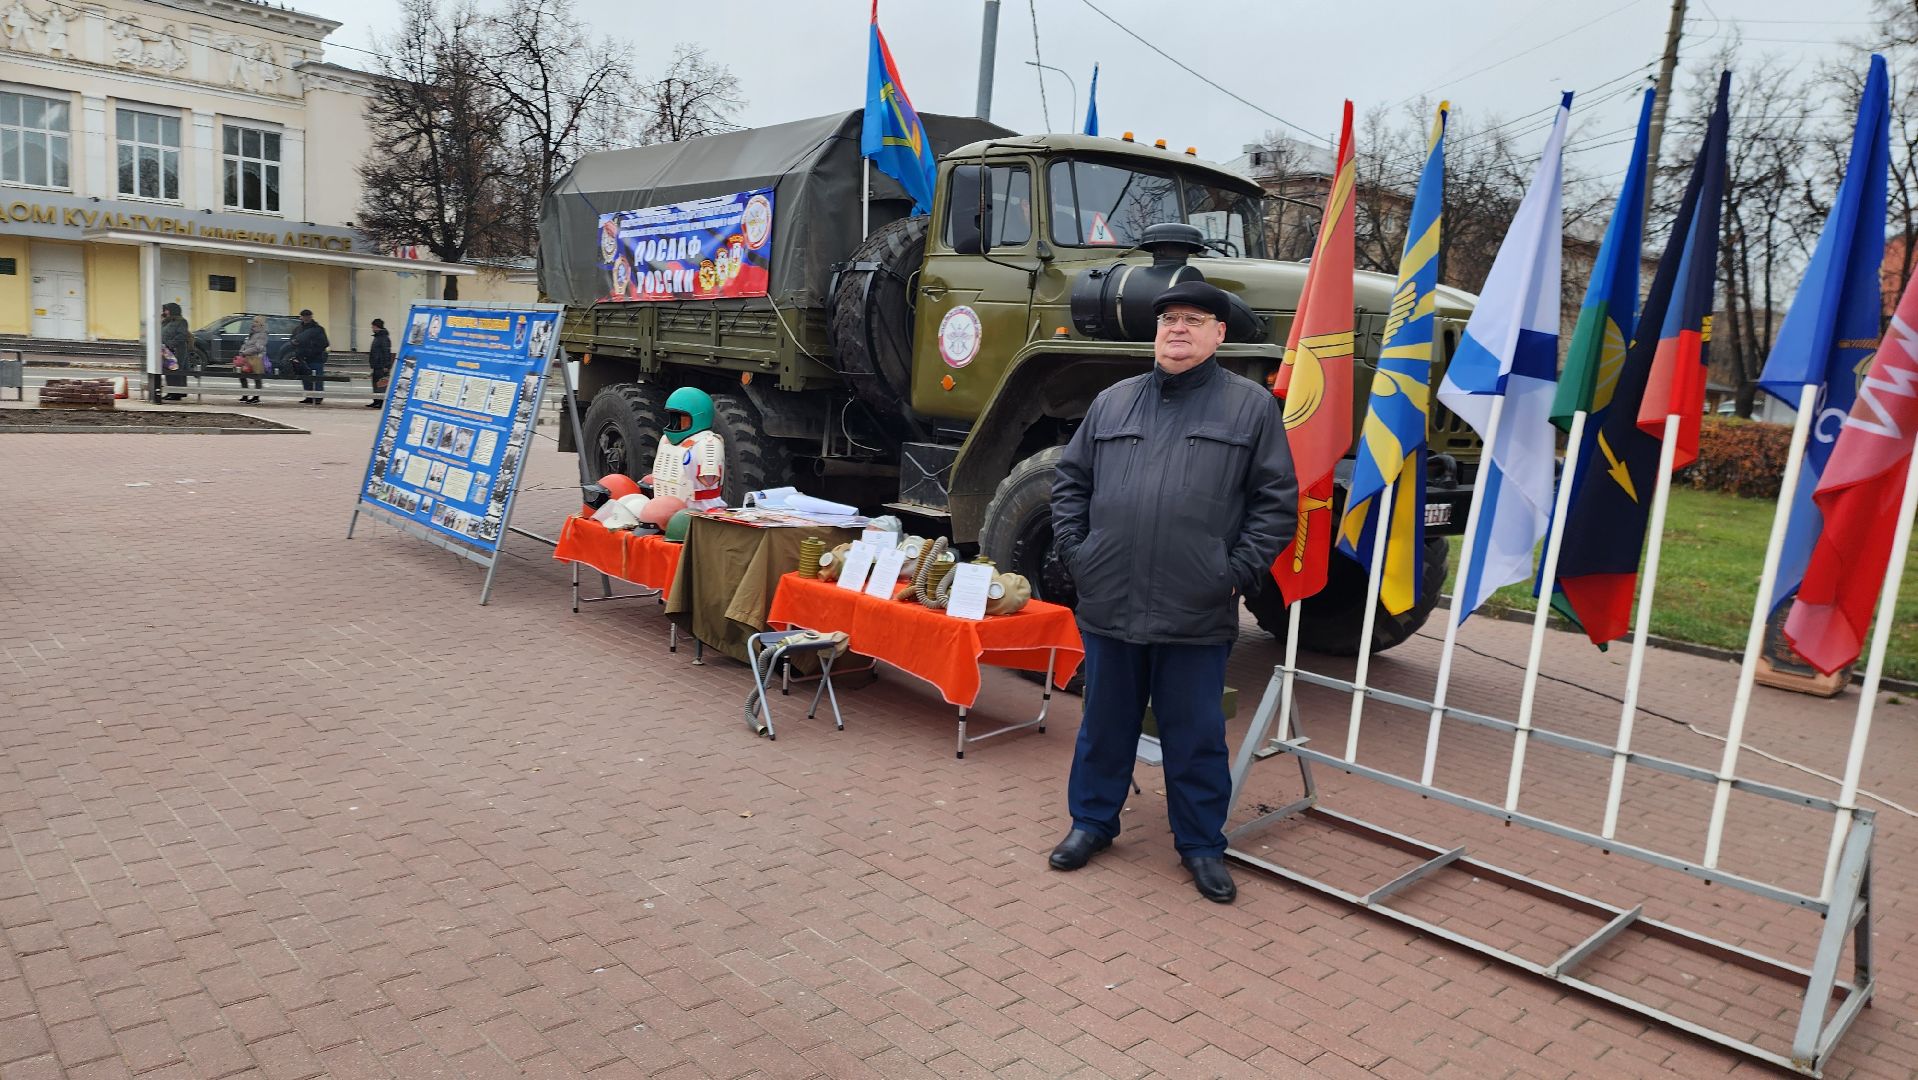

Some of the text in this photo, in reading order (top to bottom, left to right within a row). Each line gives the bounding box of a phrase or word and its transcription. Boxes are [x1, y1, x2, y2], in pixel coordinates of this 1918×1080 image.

[63, 207, 195, 235] КУЛЬТУРЫ
[634, 235, 702, 266] ДОСААФ
[636, 268, 695, 294] РОССИИ
